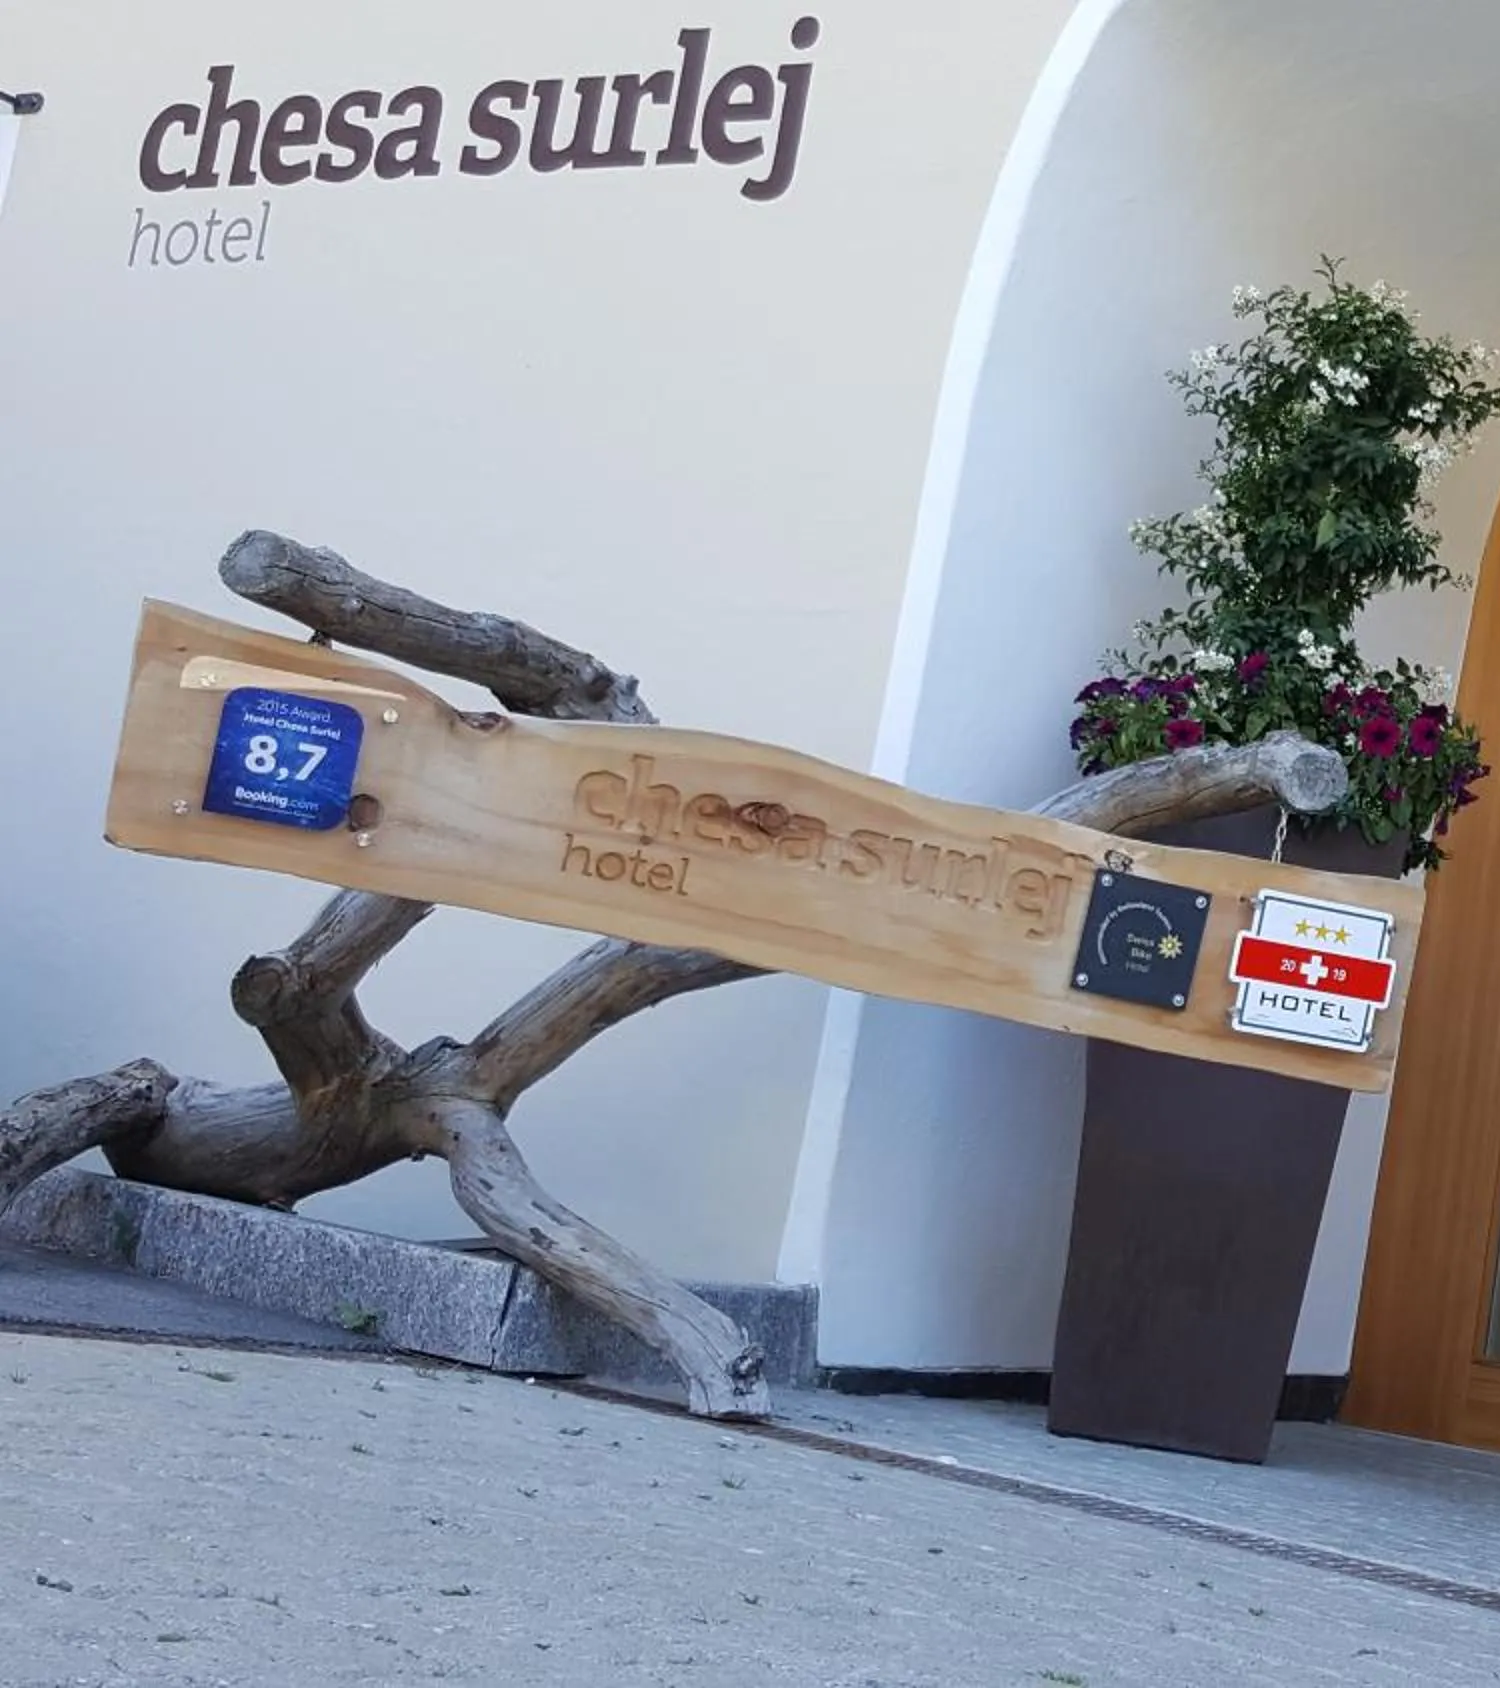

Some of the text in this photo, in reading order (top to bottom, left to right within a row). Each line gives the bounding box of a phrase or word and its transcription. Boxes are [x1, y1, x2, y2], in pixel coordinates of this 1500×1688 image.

[139, 16, 820, 202] chesa surlej
[128, 201, 271, 268] hotel
[257, 699, 288, 716] 2015
[244, 735, 328, 782] 8,7
[235, 785, 320, 812] Booking.com
[560, 833, 690, 897] hotel
[574, 753, 828, 870] chesa
[841, 828, 1097, 941] surlej
[1279, 957, 1347, 982] 20 19
[1258, 990, 1353, 1023] HOTEL
